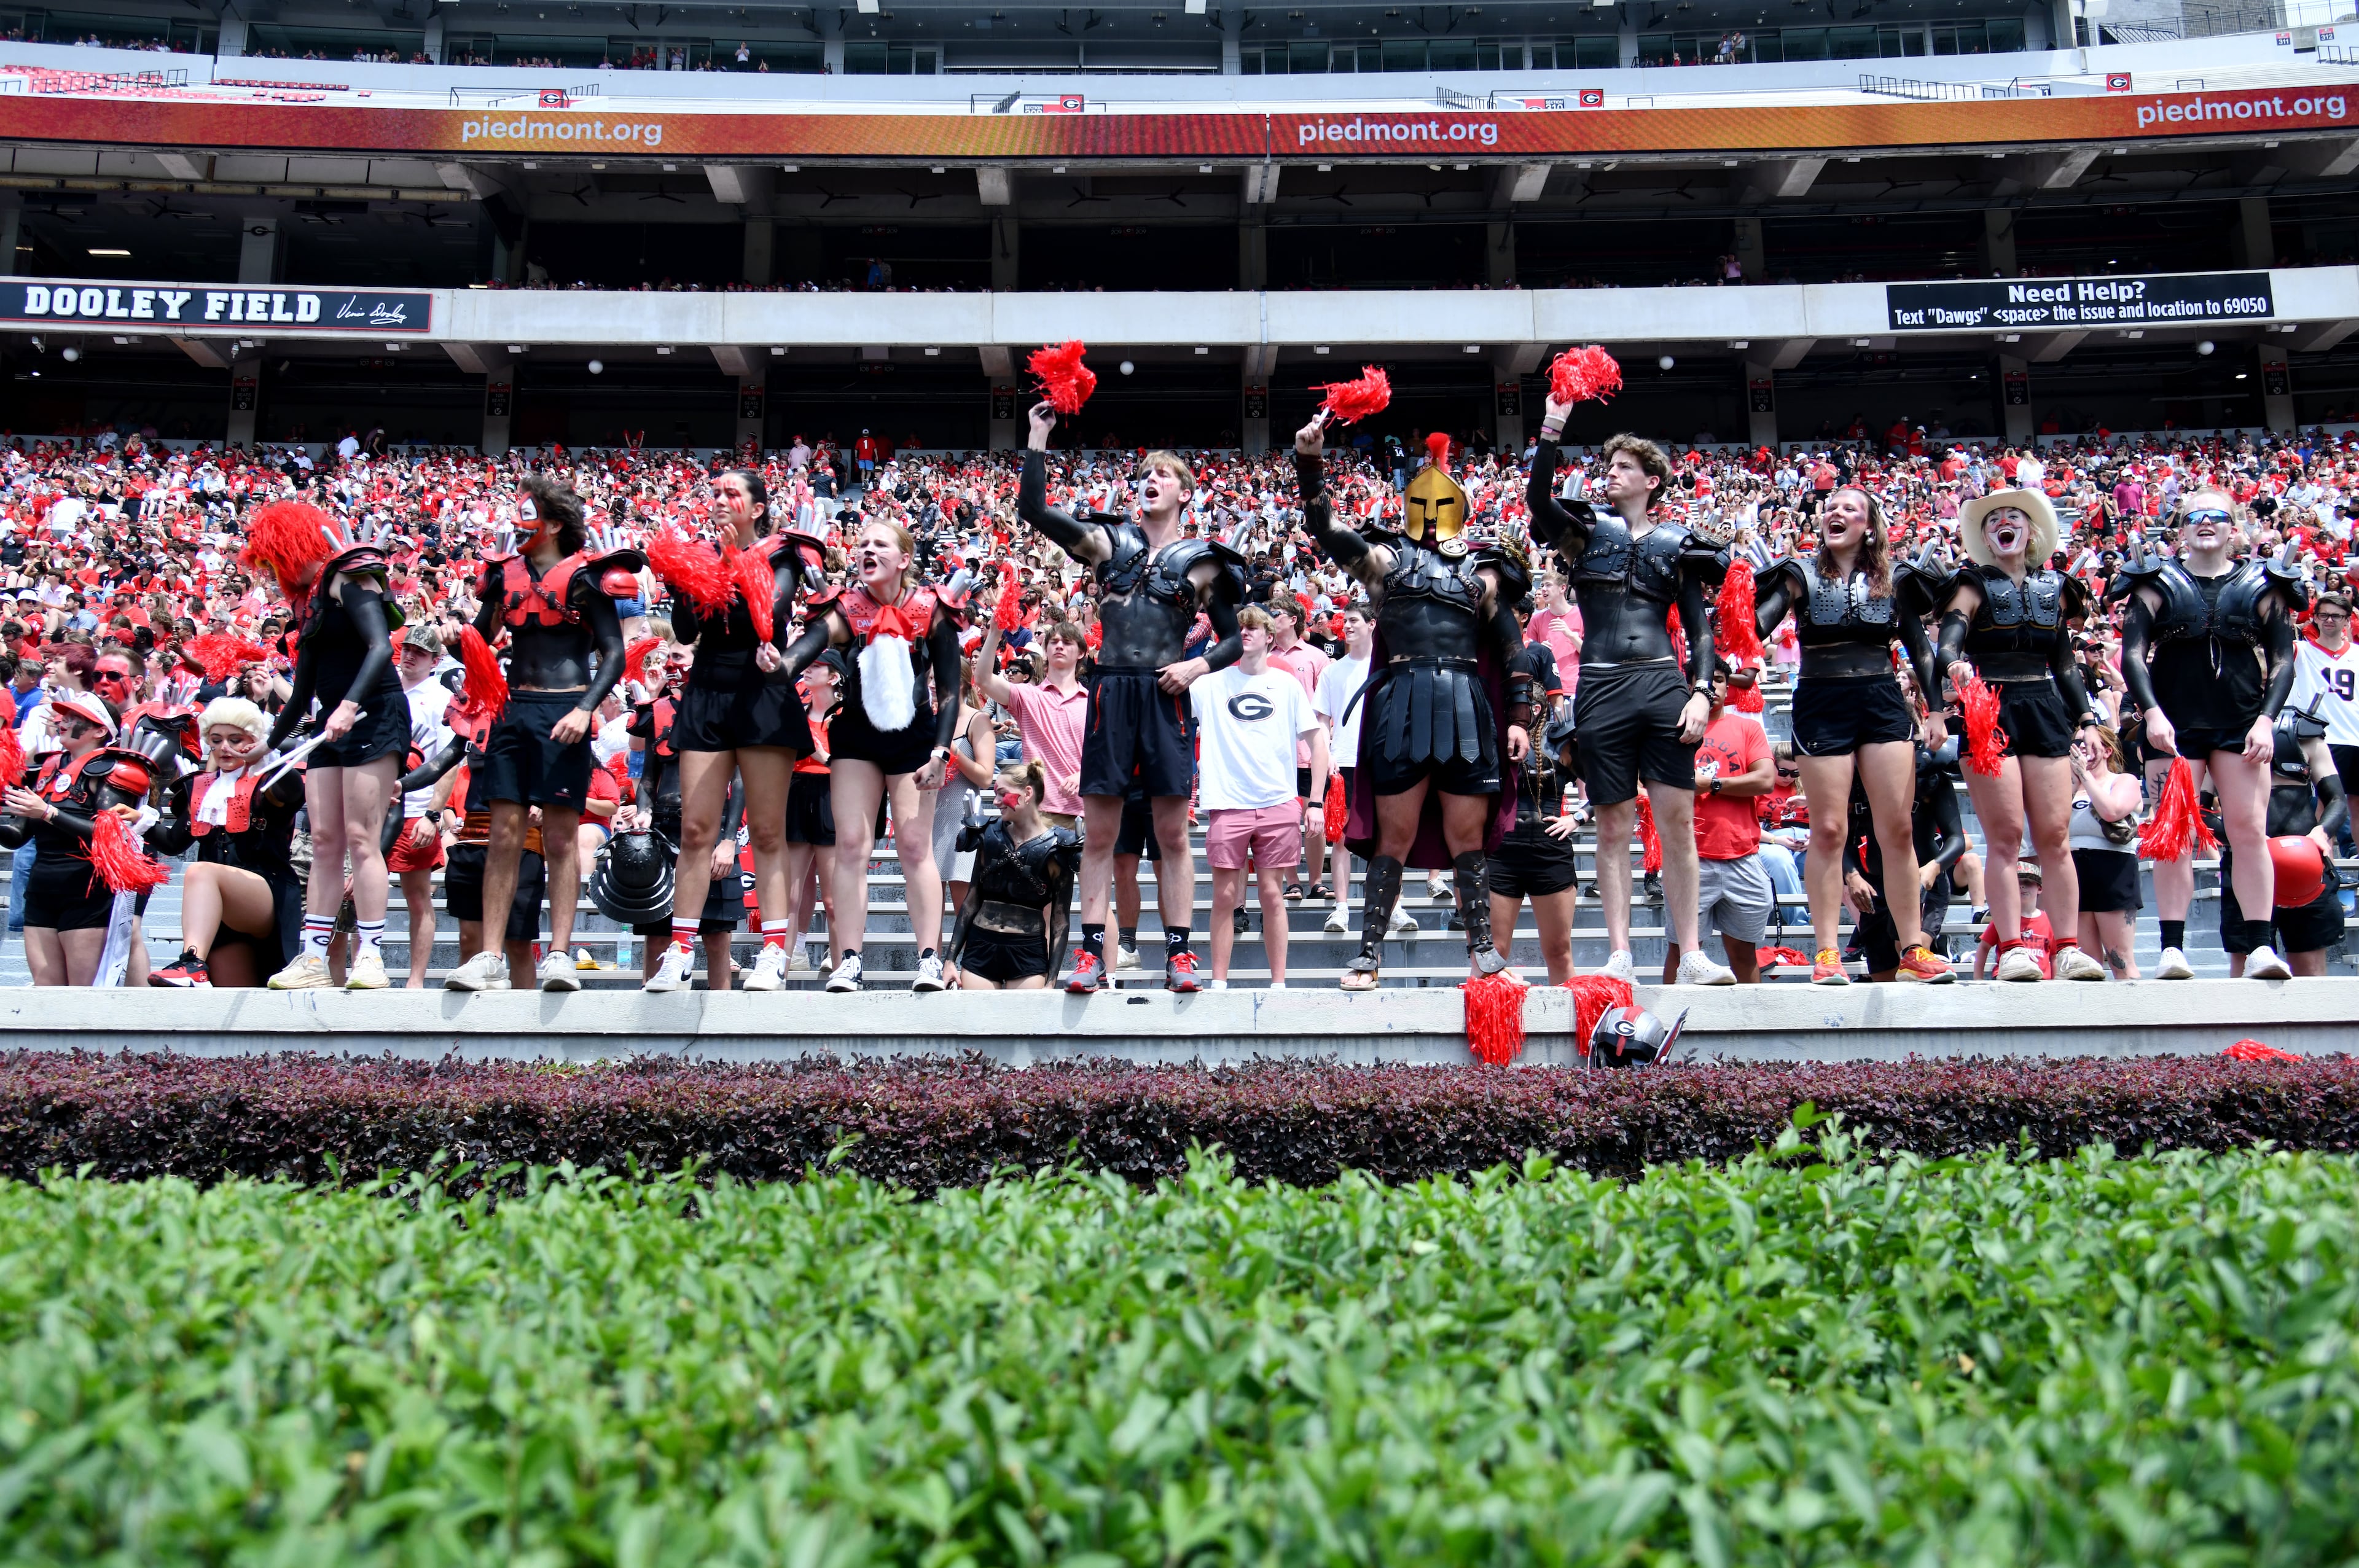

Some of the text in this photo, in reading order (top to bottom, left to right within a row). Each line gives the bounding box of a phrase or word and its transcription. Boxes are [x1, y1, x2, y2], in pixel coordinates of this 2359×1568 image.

[2109, 76, 2127, 89] G
[1063, 99, 1080, 110] G
[1582, 93, 1600, 105] G
[2137, 96, 2347, 128] piedmont.org
[462, 115, 663, 146] piedmont.org
[1299, 117, 1498, 146] piedmont.org
[2008, 281, 2146, 303] Need Help?
[25, 286, 321, 322] DOOLEY FIELD
[1895, 297, 2267, 326] Text "Dawgs" <space> the issue and location to 69050
[1856, 428, 1864, 437] 19
[863, 439, 868, 450] 1
[1395, 448, 1405, 458] 14
[425, 494, 433, 505] 3
[1360, 503, 1366, 516] 1
[856, 619, 875, 628] DAW
[2321, 667, 2355, 701] 19
[1226, 692, 1275, 722] G
[1704, 738, 1740, 773] RGIA
[2071, 800, 2089, 810] G
[313, 935, 330, 946] G
[1614, 1021, 1637, 1037] G
